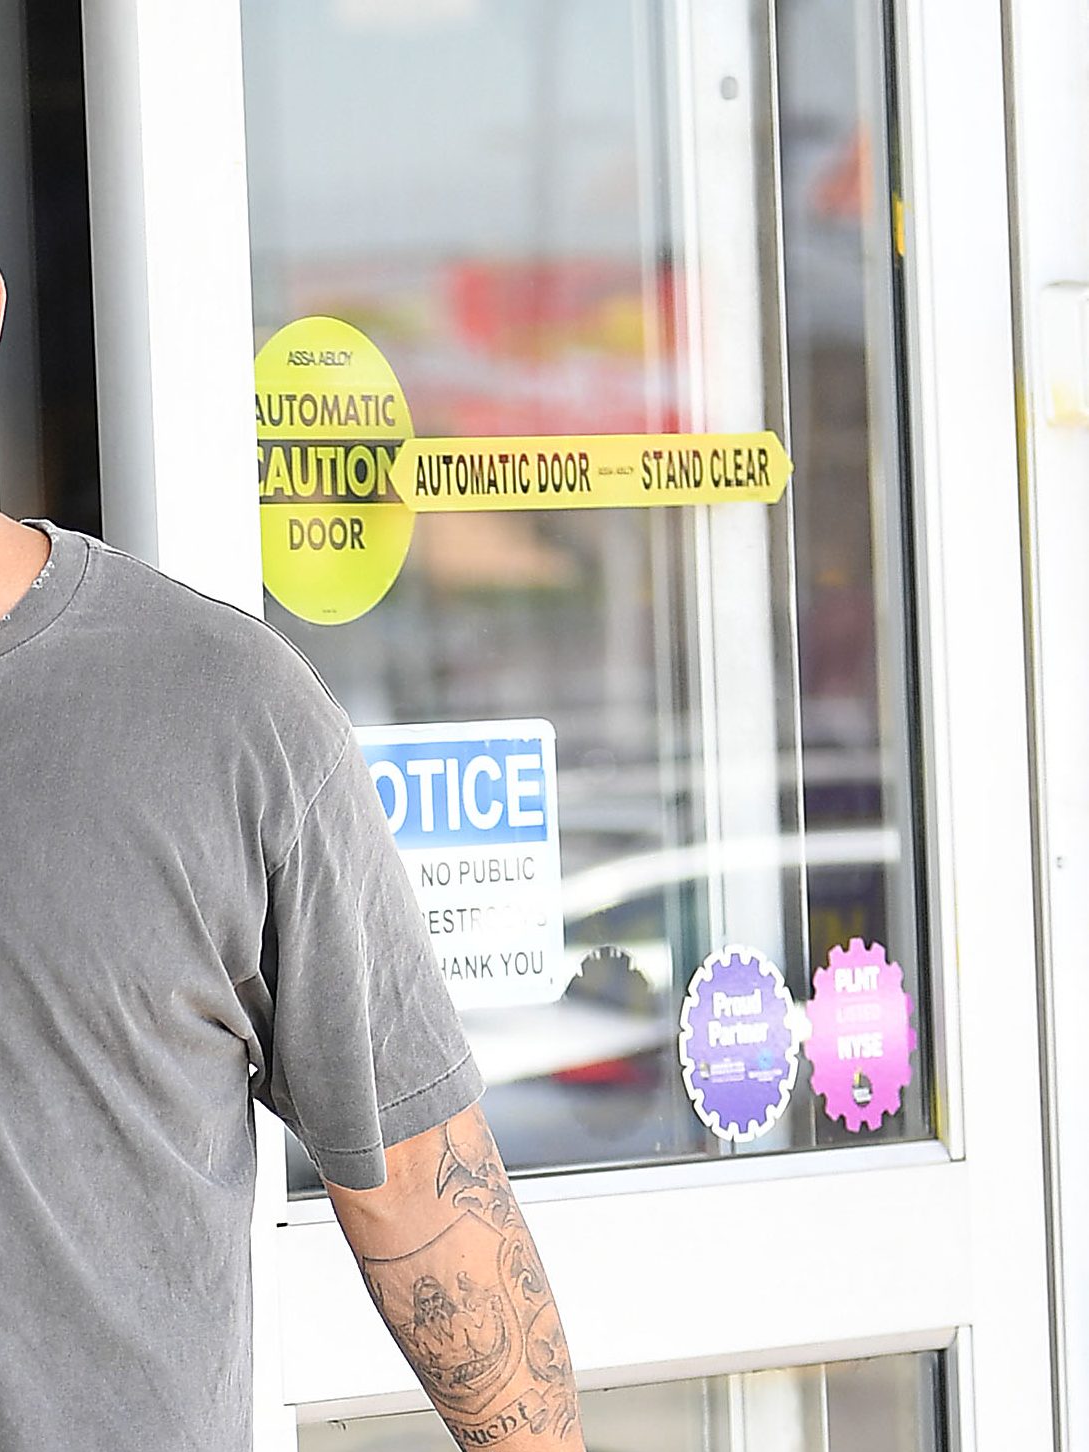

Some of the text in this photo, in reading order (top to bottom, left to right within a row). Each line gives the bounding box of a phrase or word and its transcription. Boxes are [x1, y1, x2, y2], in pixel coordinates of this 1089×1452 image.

[288, 351, 353, 365] ASSA ABLOY
[255, 393, 396, 427] AUTOMATIC
[415, 452, 591, 496] AUTOMATIC DOOR
[641, 448, 770, 490] STAND CLEAR
[289, 517, 366, 551] DOOR
[369, 754, 545, 837] OTICE
[421, 856, 536, 888] NO PUBLIC
[500, 950, 544, 977] YOU
[712, 987, 763, 1019] Proud
[707, 1020, 769, 1048] Partner
[837, 1031, 884, 1061] NYSE
